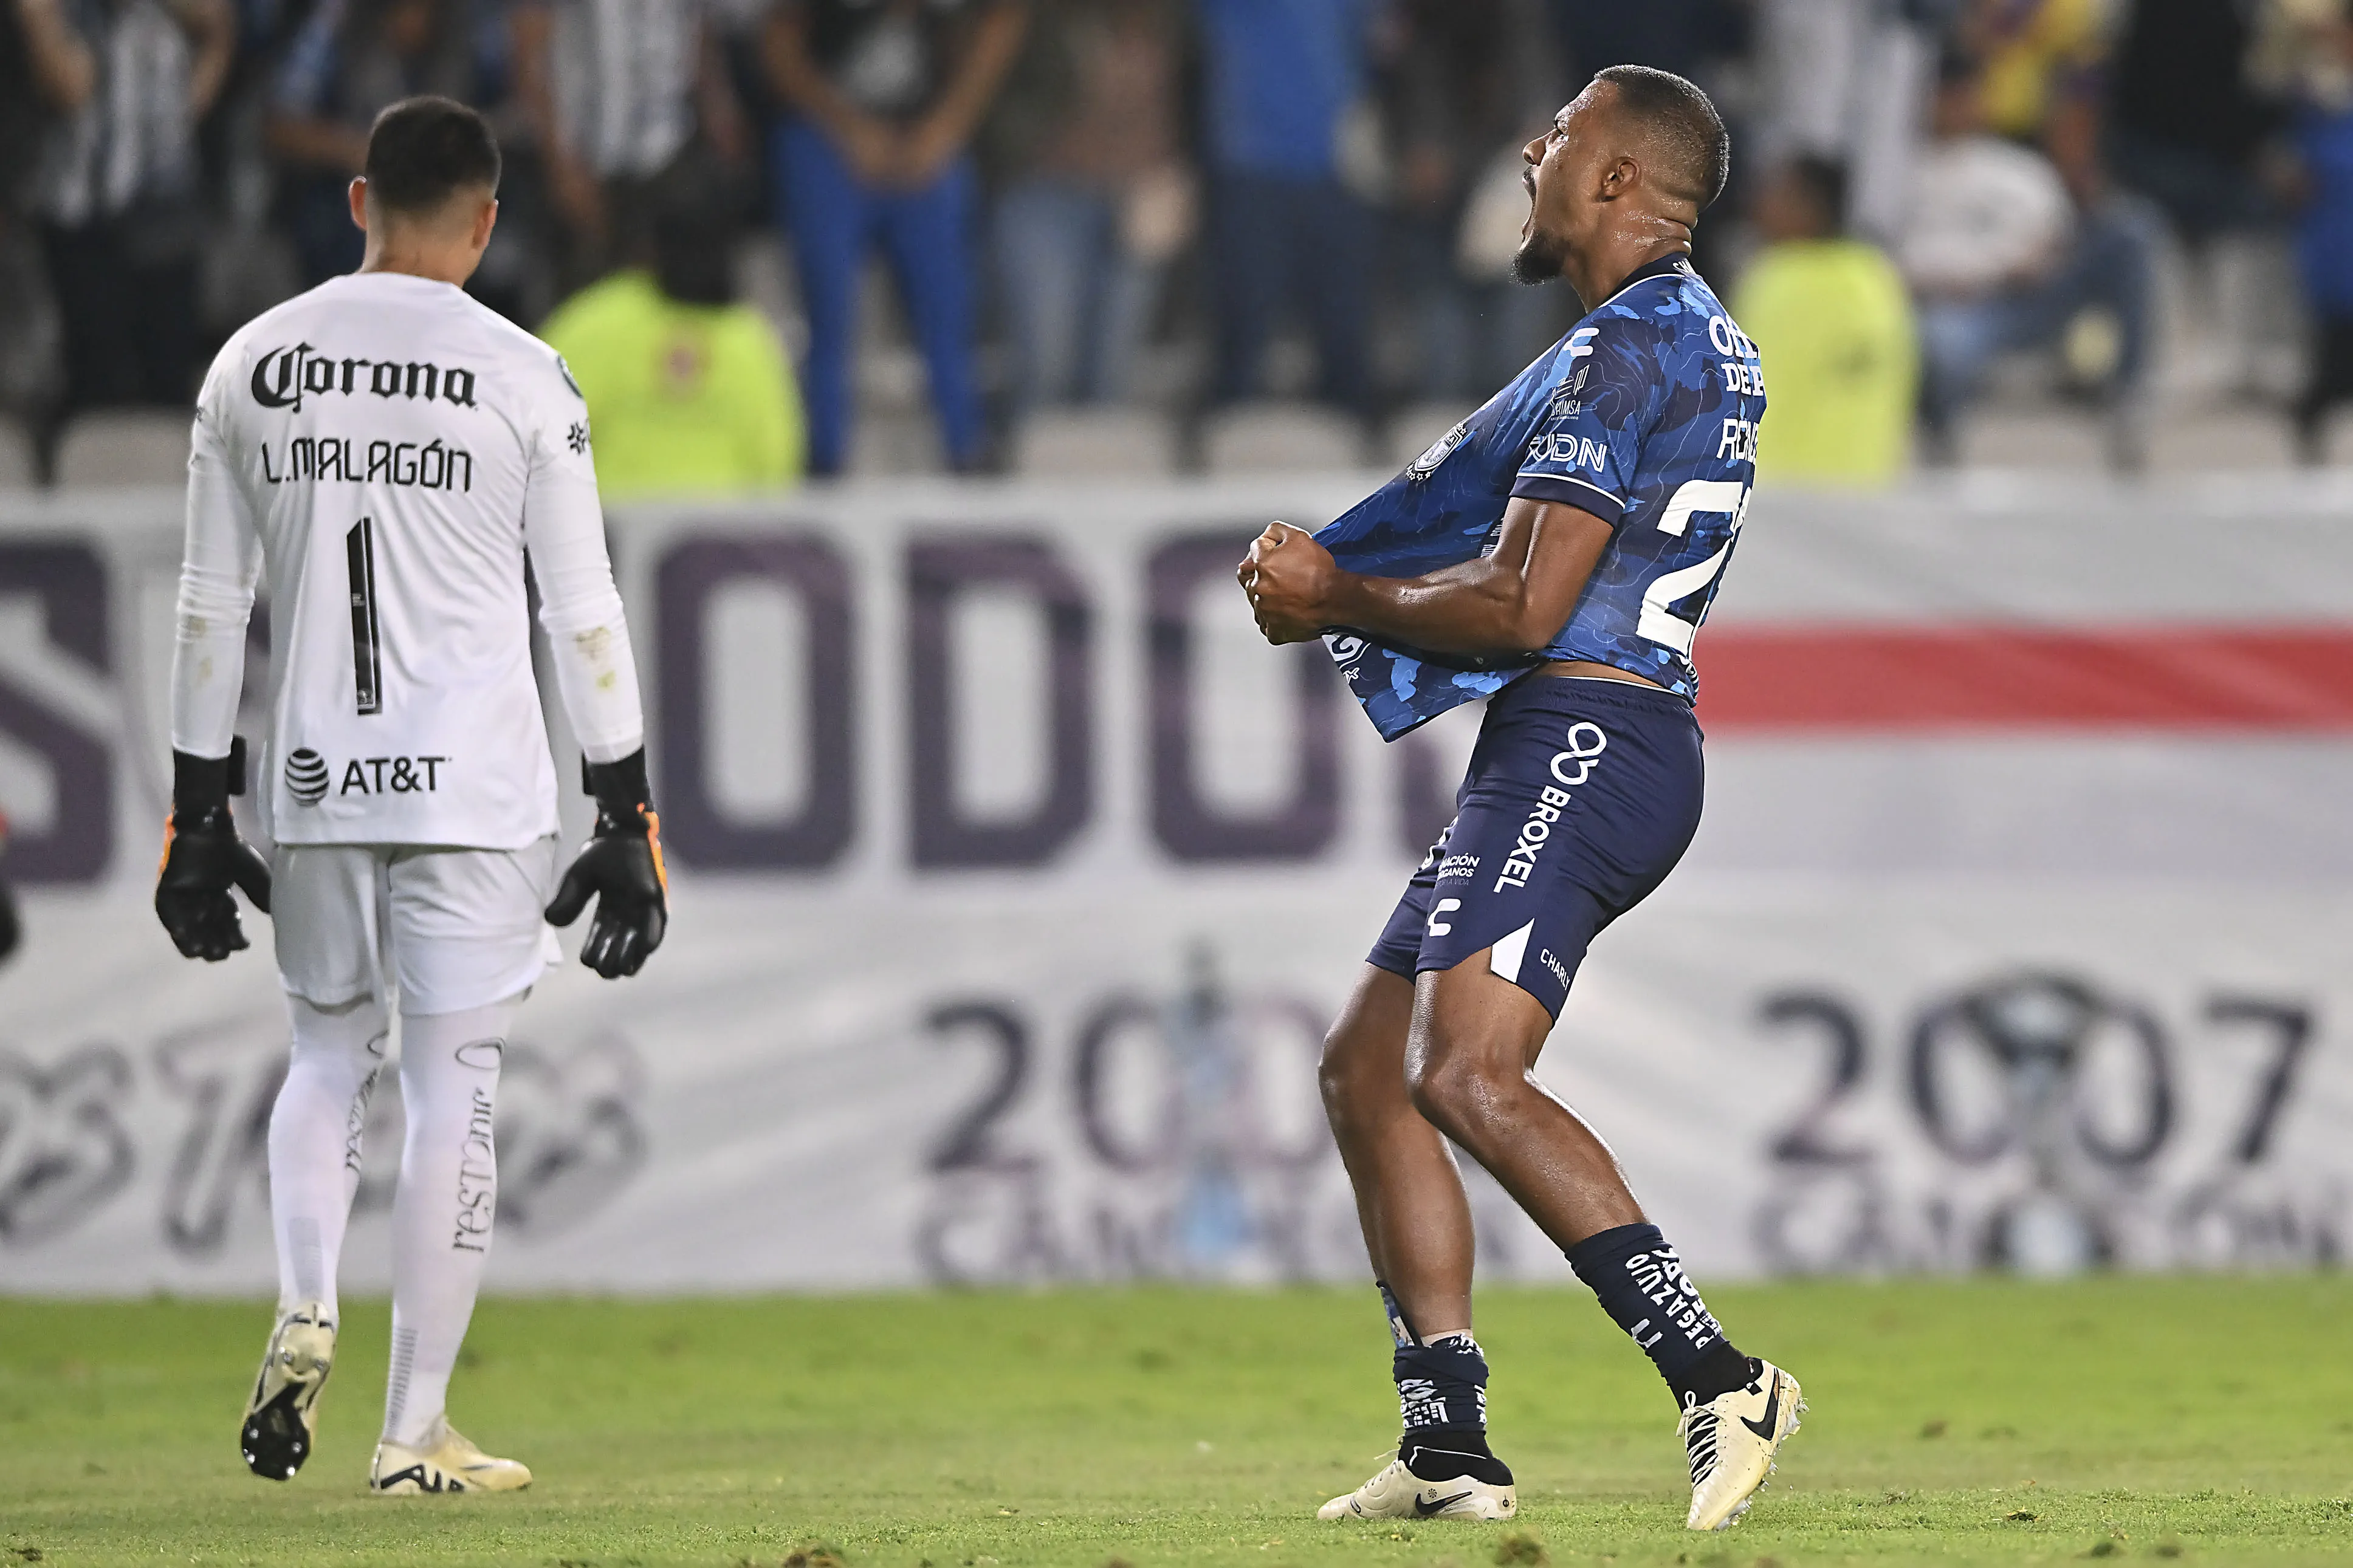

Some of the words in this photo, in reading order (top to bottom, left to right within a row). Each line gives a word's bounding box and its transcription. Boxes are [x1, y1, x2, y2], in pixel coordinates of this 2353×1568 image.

[251, 341, 477, 414] Corona
[261, 437, 472, 492] L.MALAGÓN
[348, 516, 383, 716] 1
[1635, 479, 1752, 662] 2
[340, 755, 447, 797] AT&T
[1493, 785, 1572, 894] BROXEL
[1540, 948, 1571, 991] CHARLY
[1753, 991, 2318, 1169] 2007
